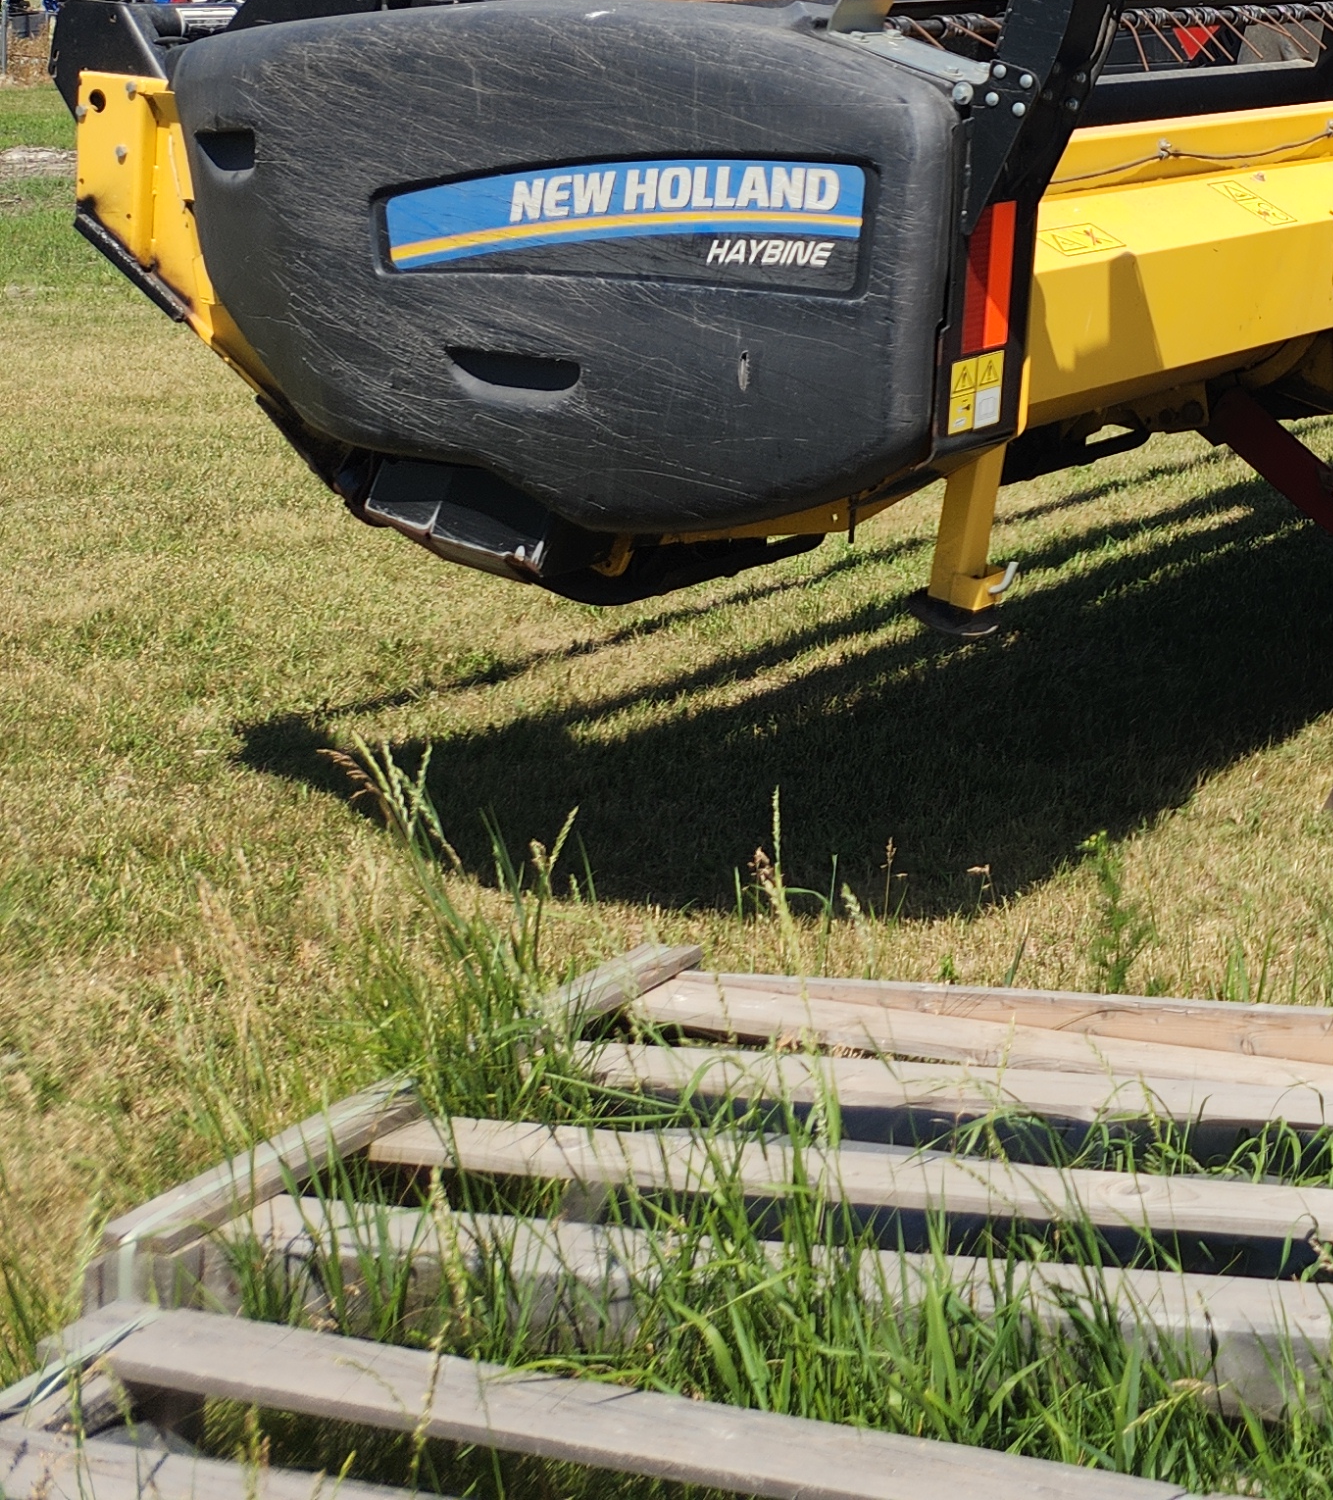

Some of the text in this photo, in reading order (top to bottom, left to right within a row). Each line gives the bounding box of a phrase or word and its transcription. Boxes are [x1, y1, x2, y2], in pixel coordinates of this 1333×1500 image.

[509, 166, 840, 223] NEW HOLLAND
[705, 239, 836, 269] HAYBINE
